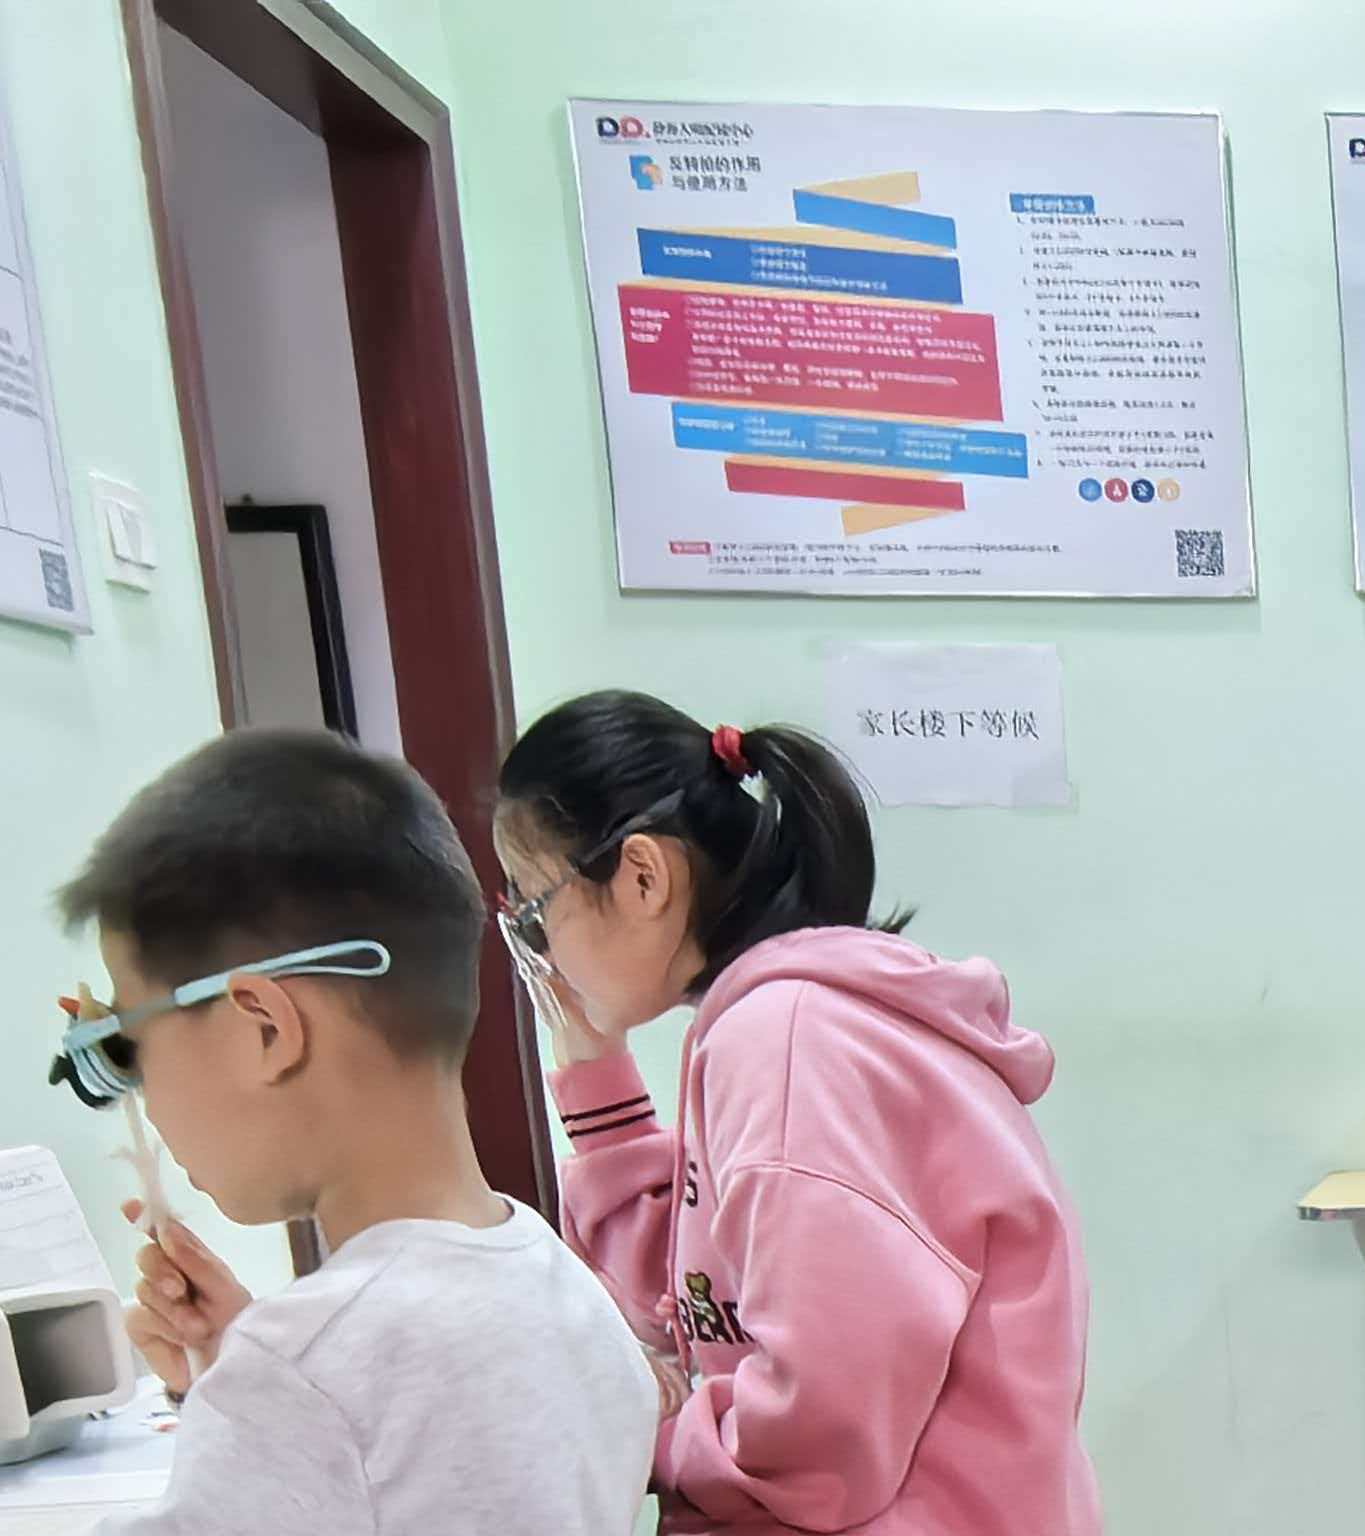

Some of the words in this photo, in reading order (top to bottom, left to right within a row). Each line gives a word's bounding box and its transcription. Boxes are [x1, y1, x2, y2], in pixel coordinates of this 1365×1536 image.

[857, 708, 1040, 741] 家长楼下等候
